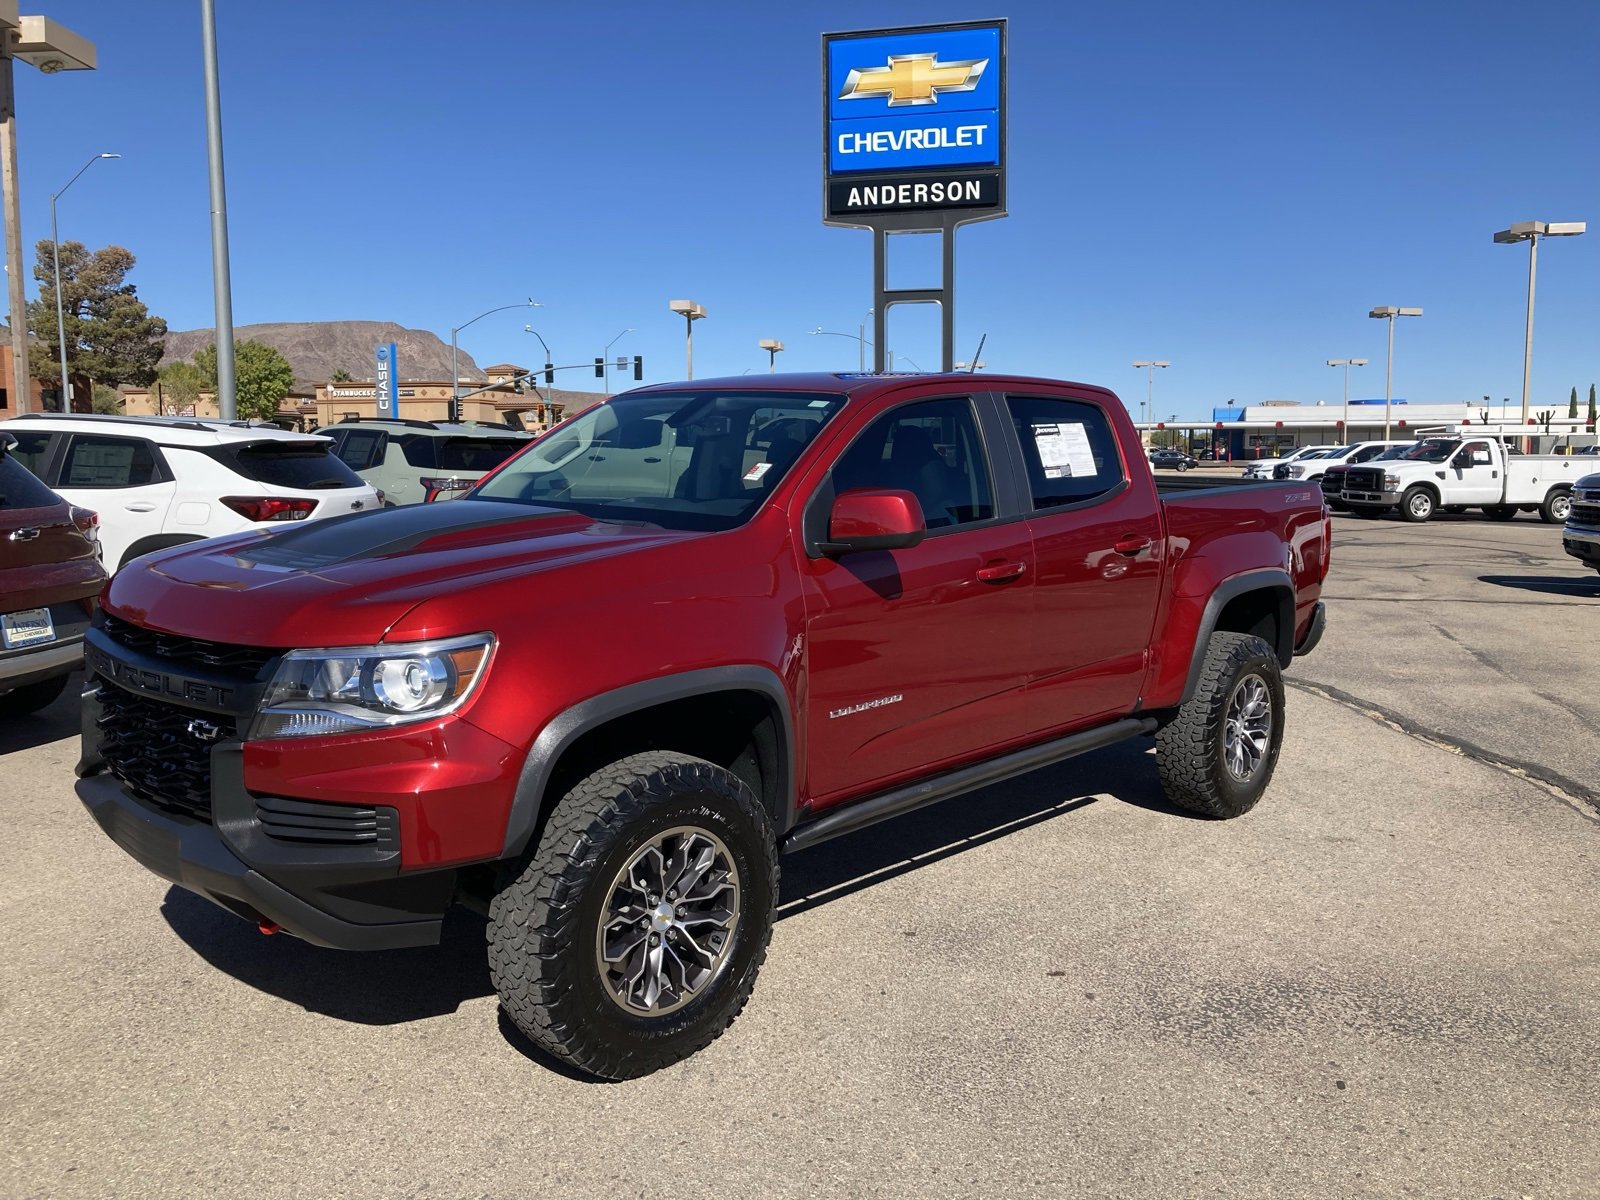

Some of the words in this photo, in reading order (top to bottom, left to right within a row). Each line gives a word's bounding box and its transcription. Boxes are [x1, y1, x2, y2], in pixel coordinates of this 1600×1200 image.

[838, 124, 988, 154] CHEVROLET
[847, 180, 981, 207] ANDERSON
[332, 390, 371, 398] STARBUCKS
[377, 361, 389, 410] CHASE
[92, 648, 234, 706] EVROLET
[829, 693, 904, 719] COLORADO
